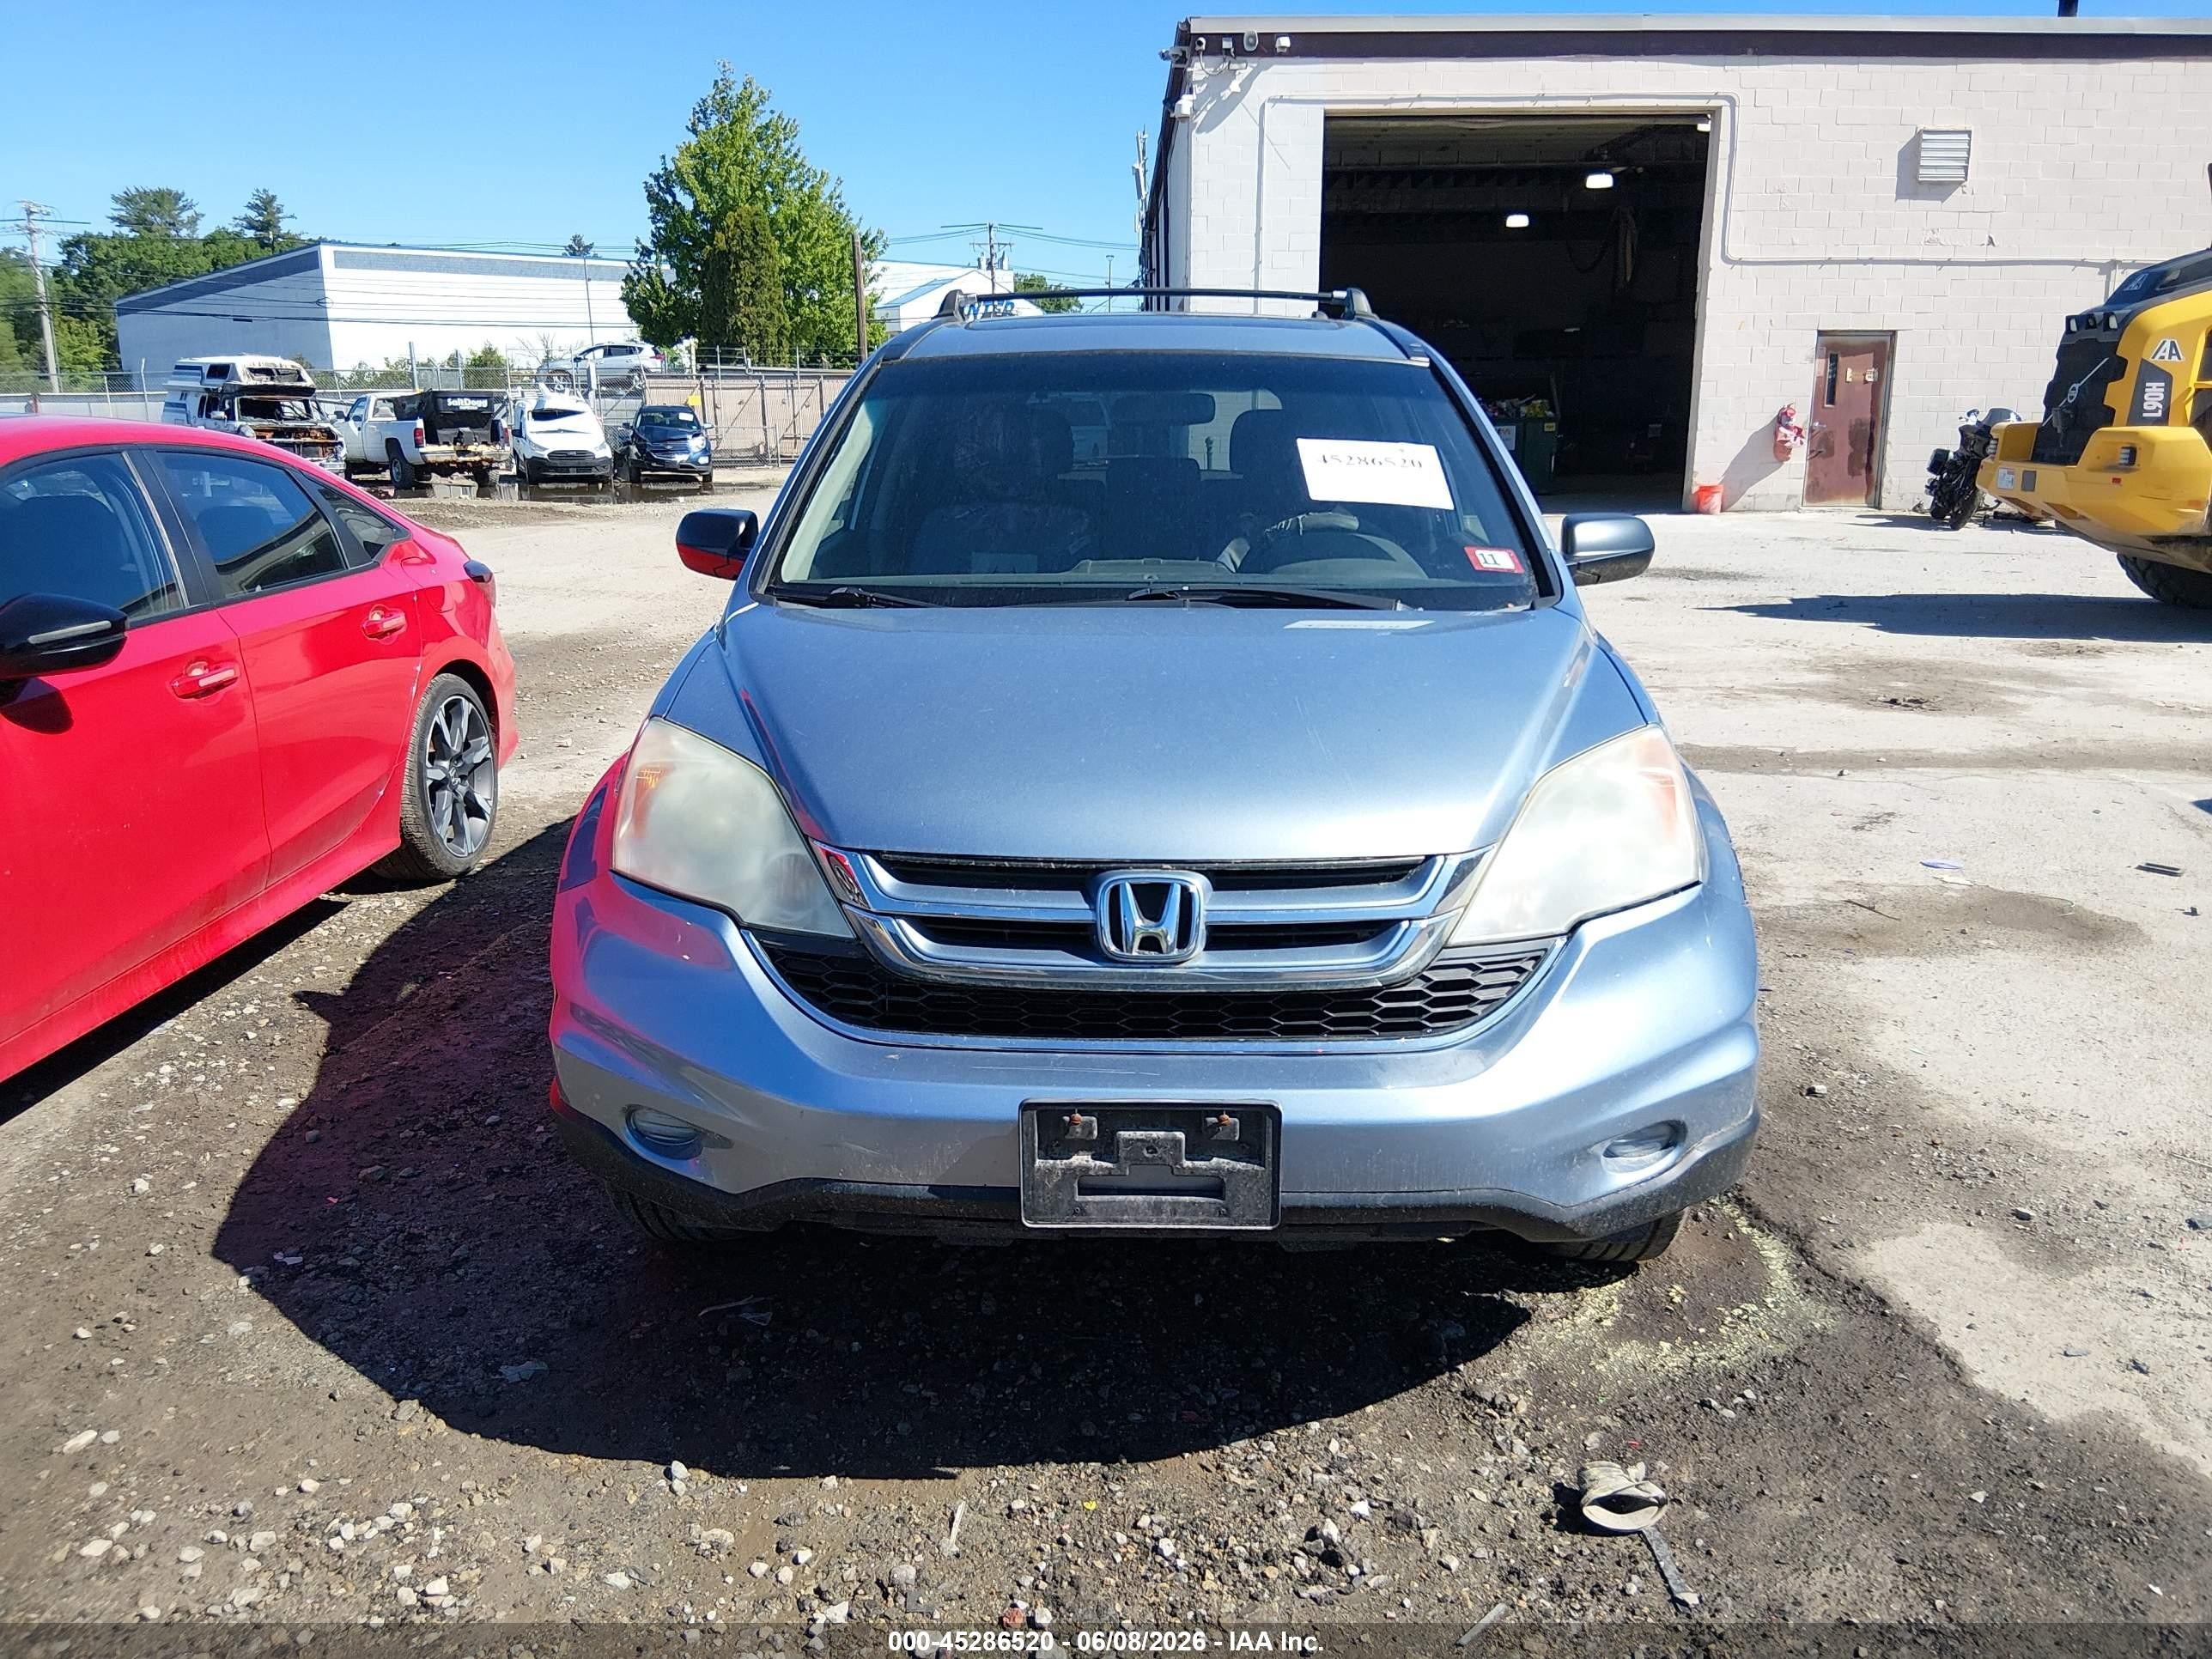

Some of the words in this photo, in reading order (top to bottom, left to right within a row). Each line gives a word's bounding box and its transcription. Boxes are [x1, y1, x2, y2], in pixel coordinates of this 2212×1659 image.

[447, 398, 488, 408] SaltDogg
[2142, 382, 2166, 417] L90H
[1479, 553, 1500, 566] 11
